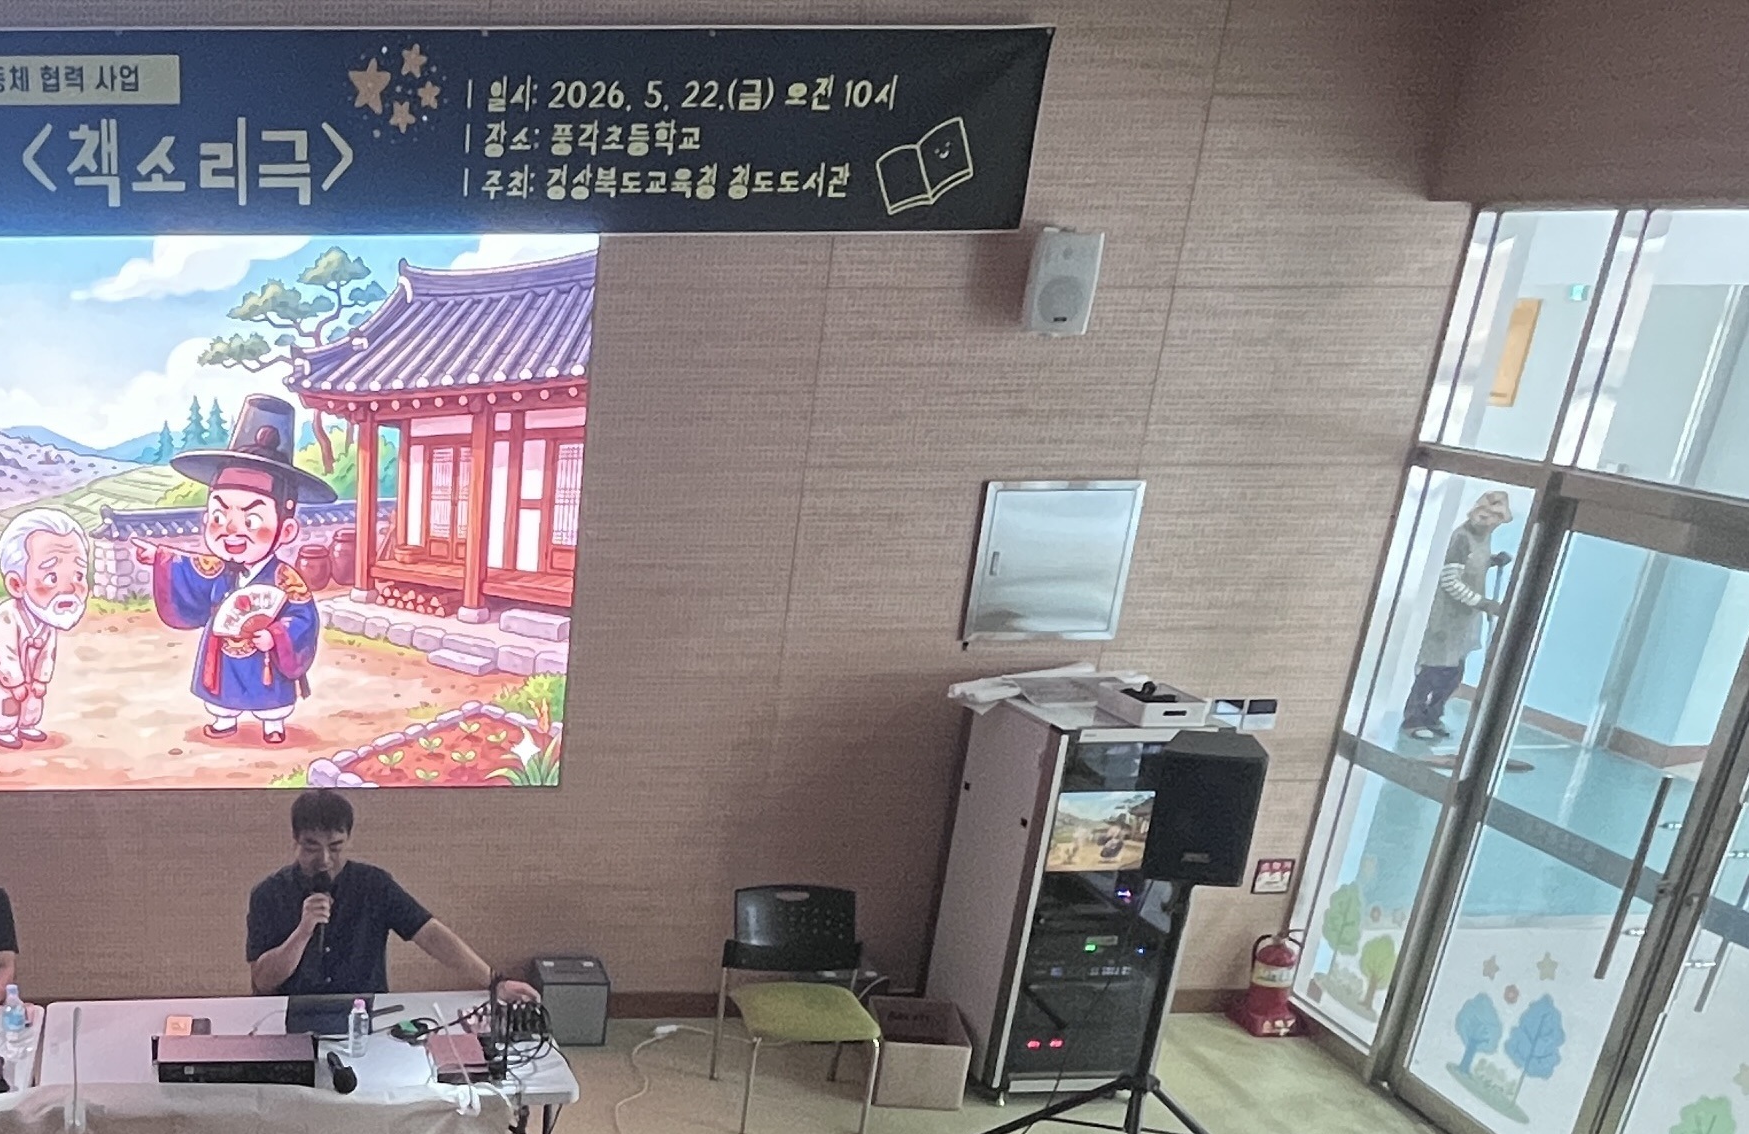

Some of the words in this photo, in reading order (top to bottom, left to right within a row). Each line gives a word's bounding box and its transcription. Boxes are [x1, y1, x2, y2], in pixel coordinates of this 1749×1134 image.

[40, 64, 85, 93] 협력
[95, 64, 140, 93] 사업
[487, 74, 538, 113] 일시:
[548, 80, 632, 113] 2026.
[644, 80, 669, 113] 5.
[680, 77, 776, 112] 22.(금)
[784, 74, 835, 112] 오전
[844, 74, 900, 112] 10시
[484, 120, 540, 158] 장소:
[550, 119, 702, 157] 풍각초등학교
[481, 164, 536, 200] 주최:
[546, 162, 718, 201] 경상북도교육청
[727, 161, 851, 200] 청도도서관
